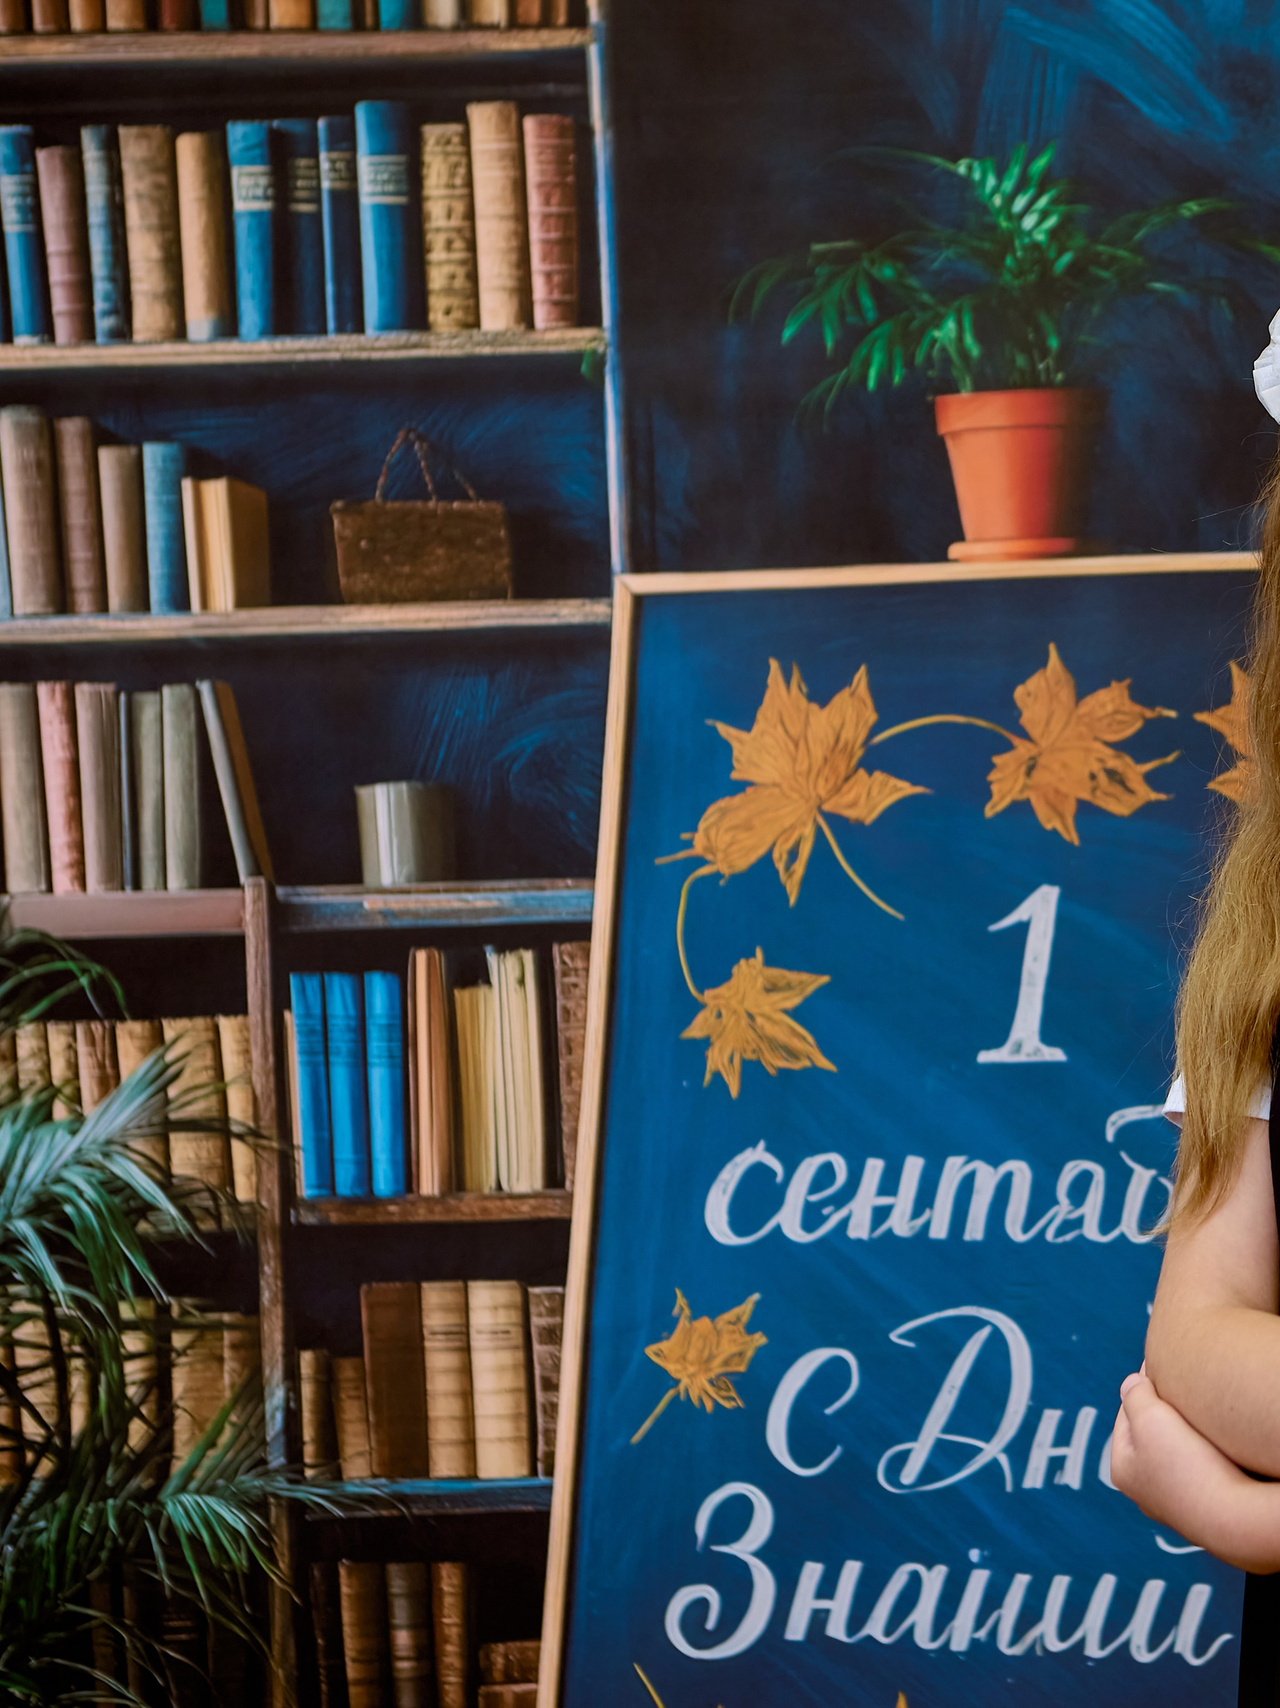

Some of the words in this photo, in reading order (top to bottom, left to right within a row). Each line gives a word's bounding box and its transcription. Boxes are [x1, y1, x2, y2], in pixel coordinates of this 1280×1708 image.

[977, 884, 1068, 1064] 1
[704, 1105, 1176, 1246] сентяб
[877, 1306, 1121, 1493] Дн
